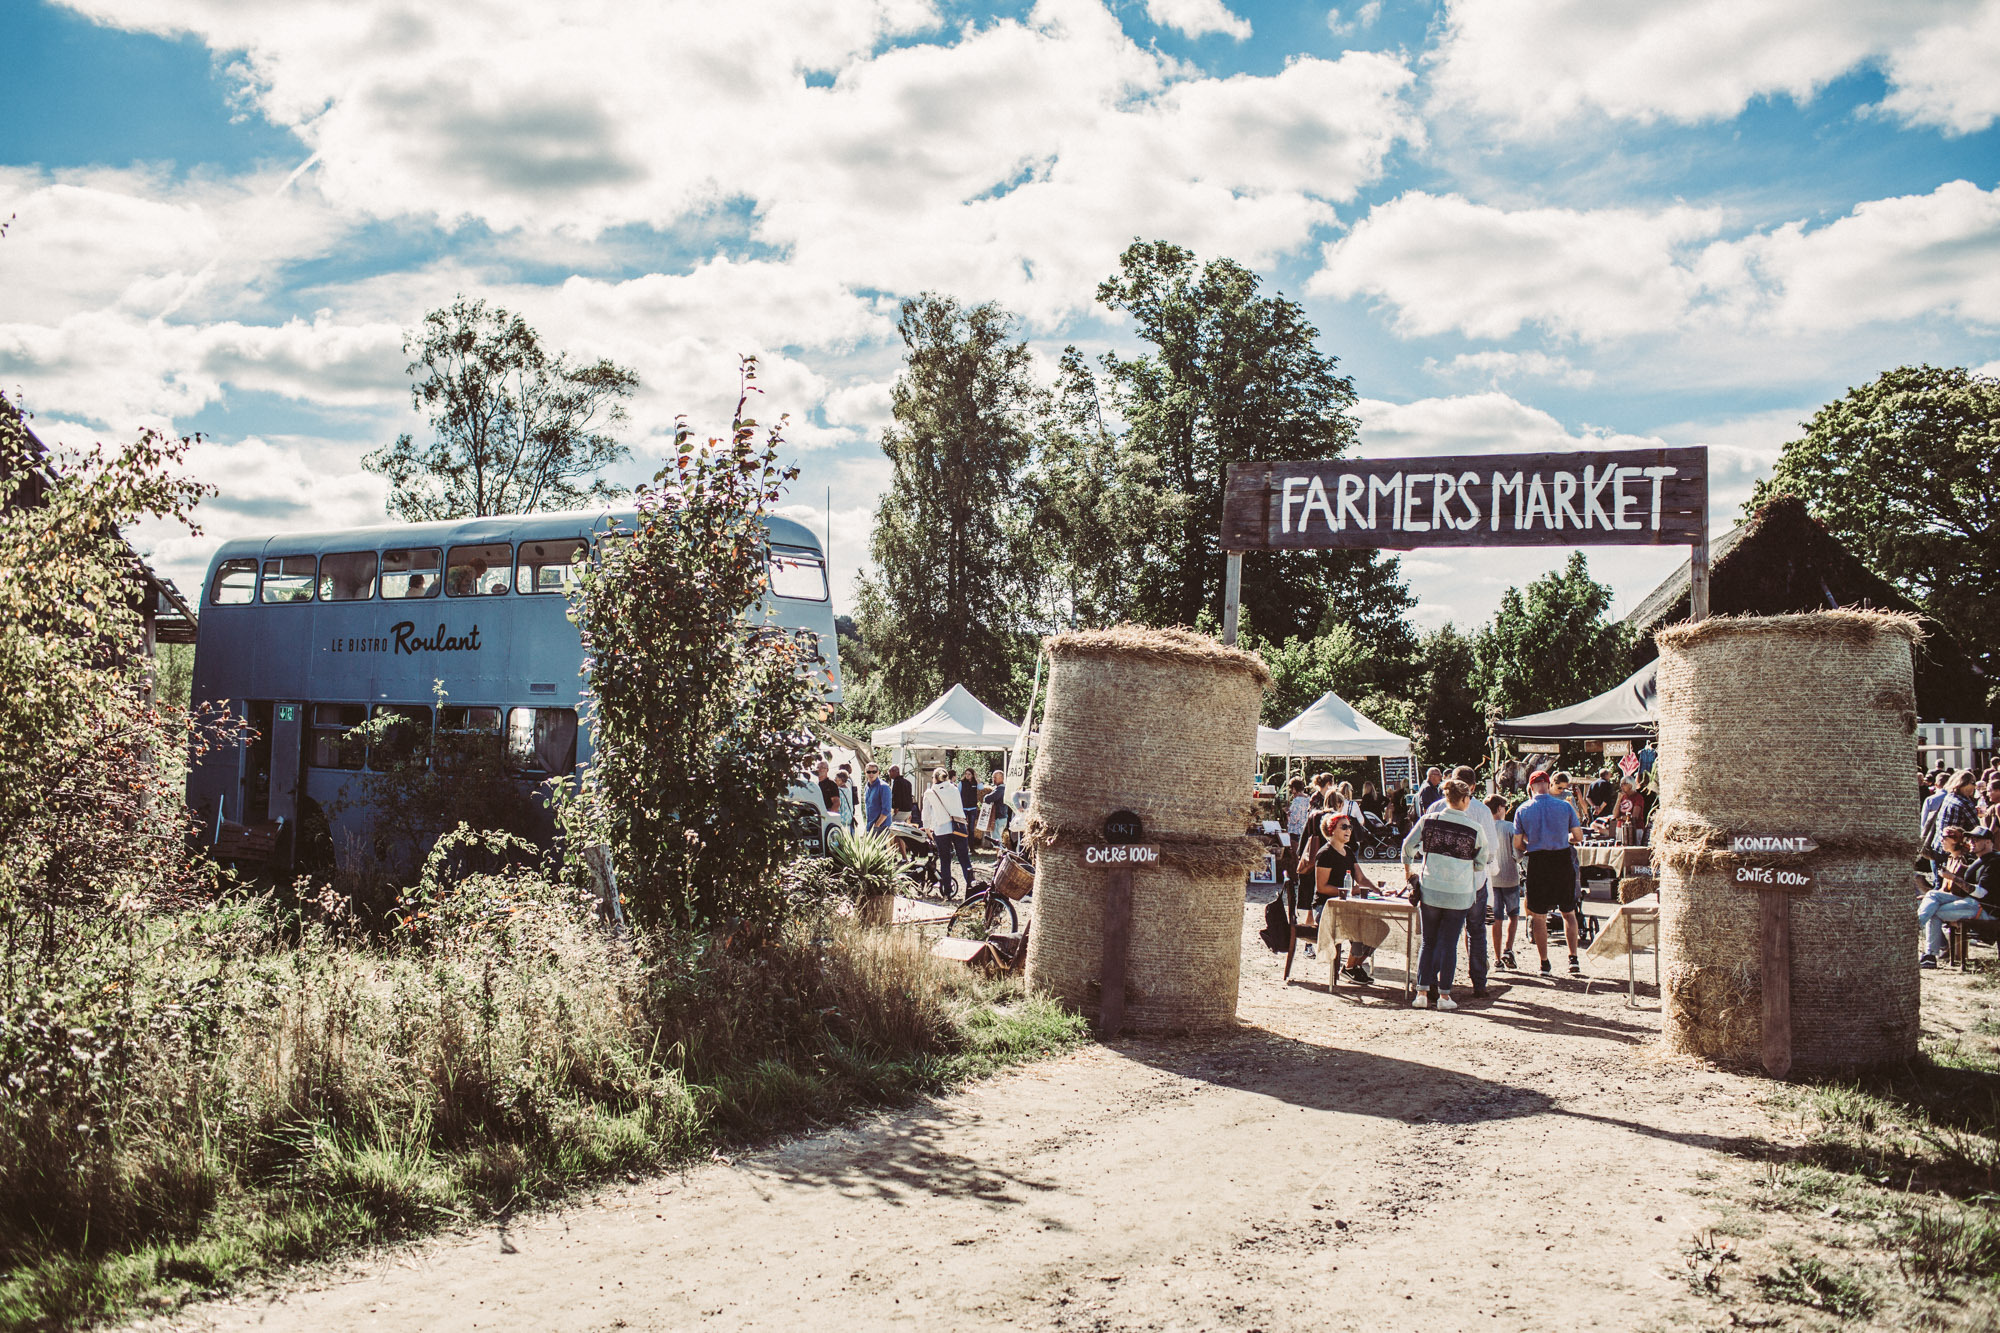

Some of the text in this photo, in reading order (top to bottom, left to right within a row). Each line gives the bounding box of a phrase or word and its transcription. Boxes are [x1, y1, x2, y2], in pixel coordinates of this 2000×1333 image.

[1281, 463, 1678, 533] FARMERS MARKET
[331, 621, 482, 655] LE BISTRO Roulant
[1107, 823, 1139, 836] KORT
[1734, 836, 1807, 851] KONTANT
